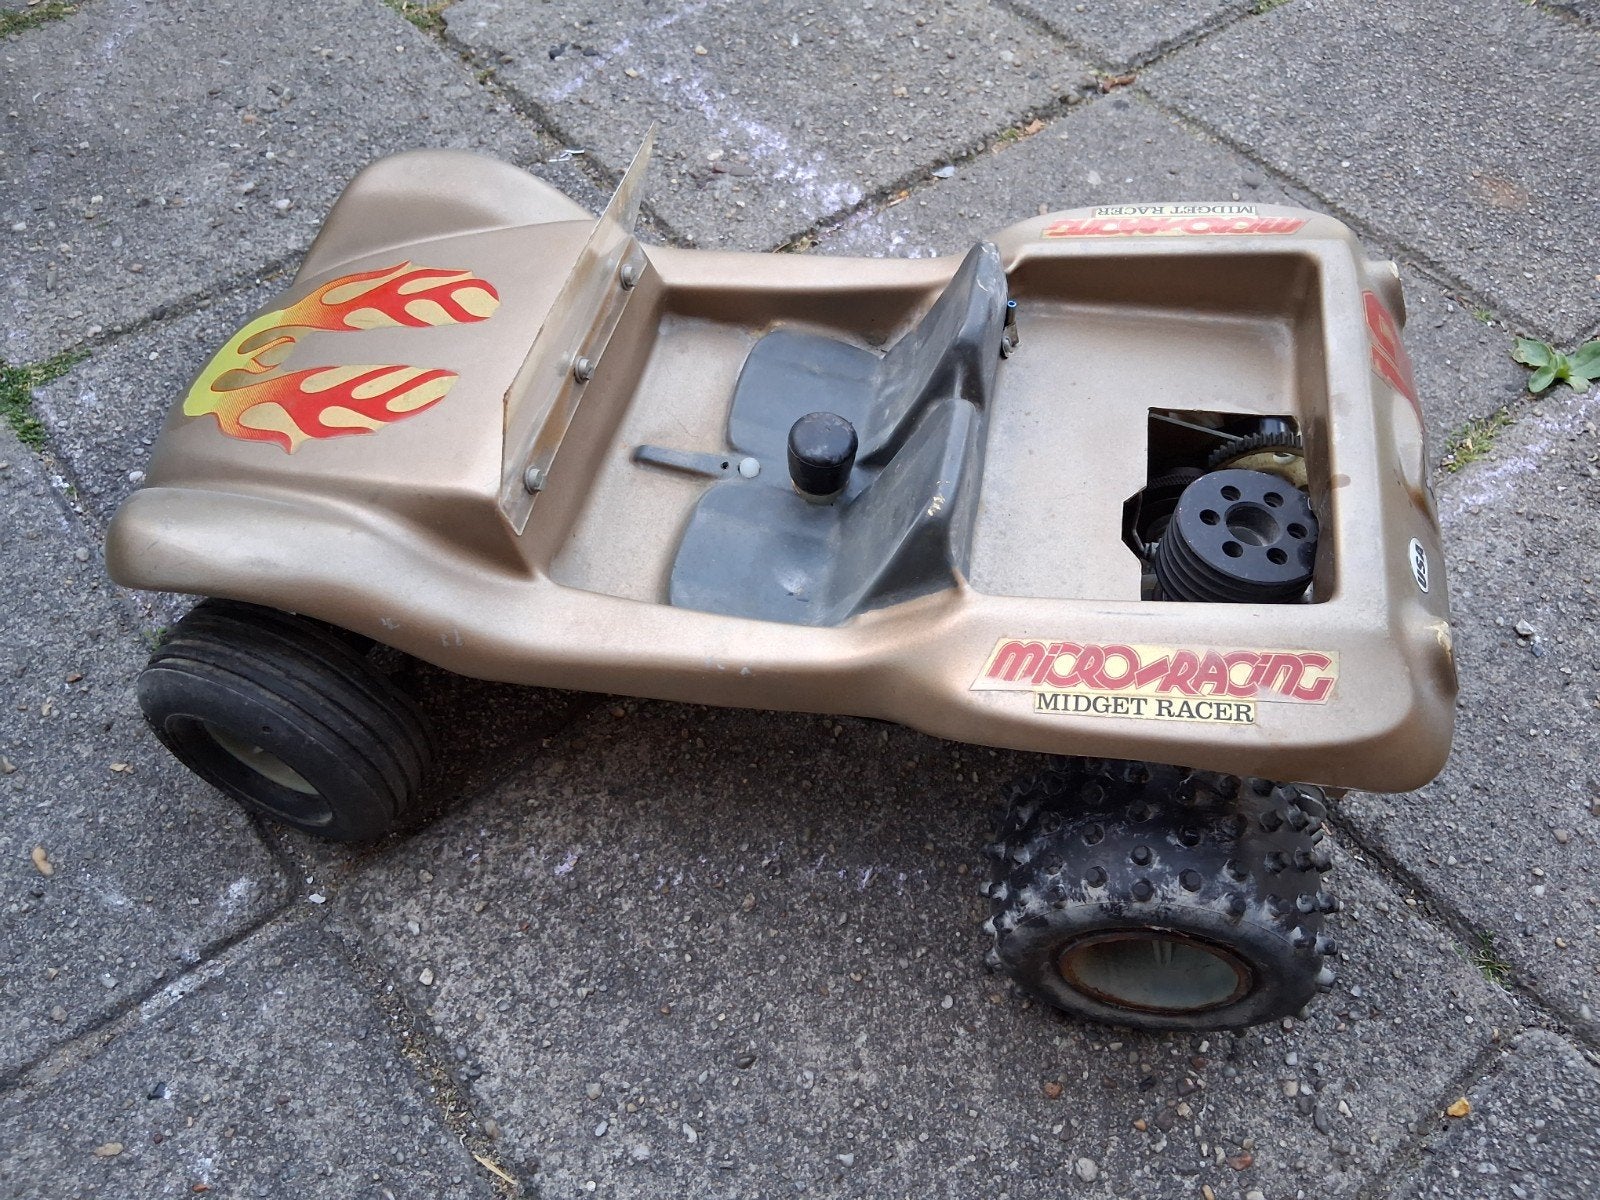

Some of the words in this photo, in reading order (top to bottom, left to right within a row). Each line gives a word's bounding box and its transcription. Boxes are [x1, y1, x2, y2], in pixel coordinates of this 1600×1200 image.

[1096, 206, 1165, 216] RACER
[1169, 205, 1255, 215] MIDGET
[1414, 543, 1427, 589] USA
[1036, 692, 1148, 717] MIDGET
[1155, 697, 1254, 723] RACER
